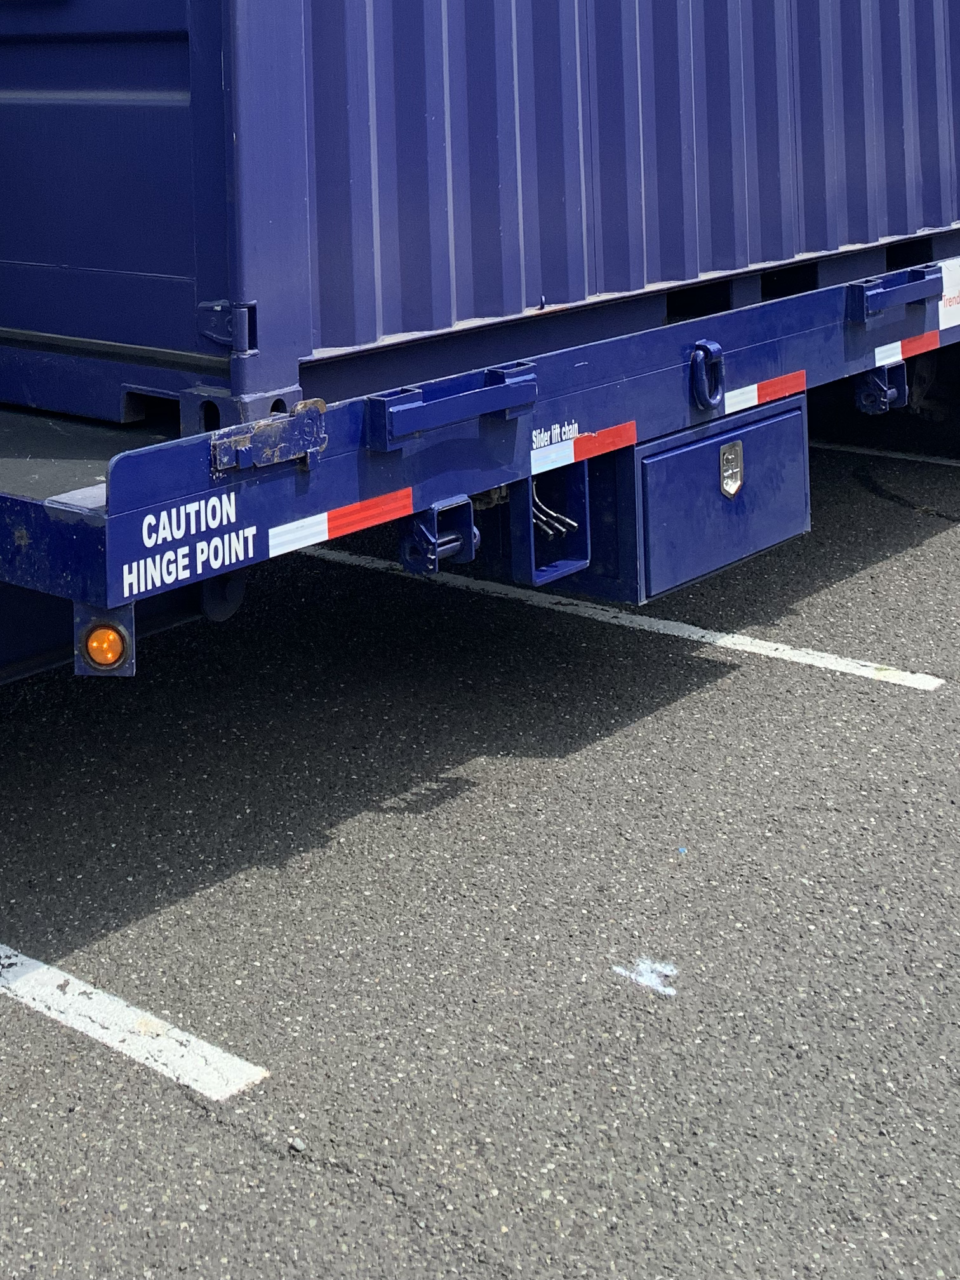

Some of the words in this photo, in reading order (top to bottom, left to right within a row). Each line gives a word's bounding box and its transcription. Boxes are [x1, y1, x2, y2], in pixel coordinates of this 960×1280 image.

[532, 428, 551, 450] Slider
[552, 423, 561, 444] lift
[562, 419, 579, 440] chain
[142, 492, 236, 548] CAUTION
[122, 545, 190, 598] HINGE
[196, 526, 257, 575] POINT
